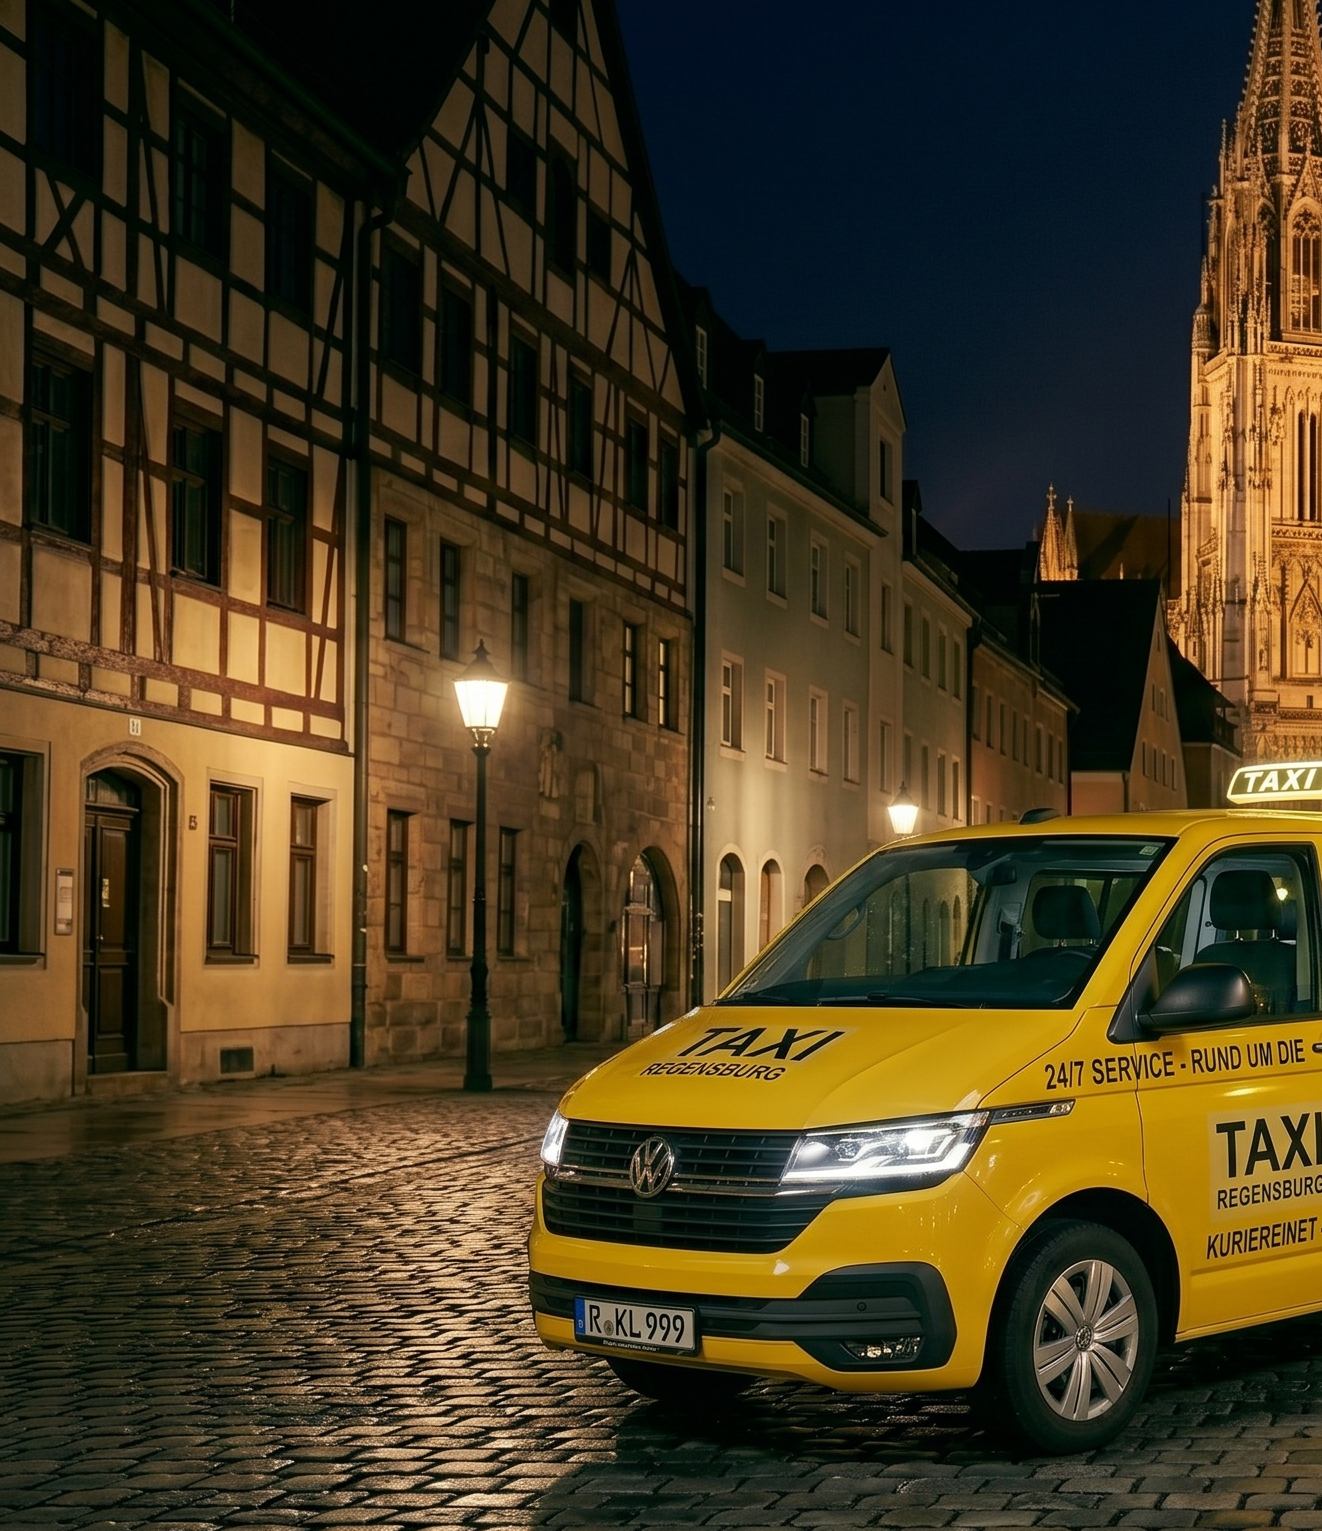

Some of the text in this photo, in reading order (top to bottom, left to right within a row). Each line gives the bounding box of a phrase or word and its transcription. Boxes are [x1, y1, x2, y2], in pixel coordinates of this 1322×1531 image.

[1244, 768, 1318, 793] TAXI
[677, 1027, 846, 1062] TAXI
[640, 1062, 787, 1081] REGENSBURG
[1044, 1060, 1085, 1090] 24/7
[1092, 1051, 1175, 1085] SERVICE
[1191, 1045, 1242, 1074] RUND
[1247, 1041, 1273, 1069] UM
[1277, 1038, 1306, 1065] DIE
[1206, 1216, 1318, 1260] KURIEREINET
[589, 1304, 602, 1334] R
[615, 1307, 642, 1339] KL
[645, 1311, 685, 1344] 999
